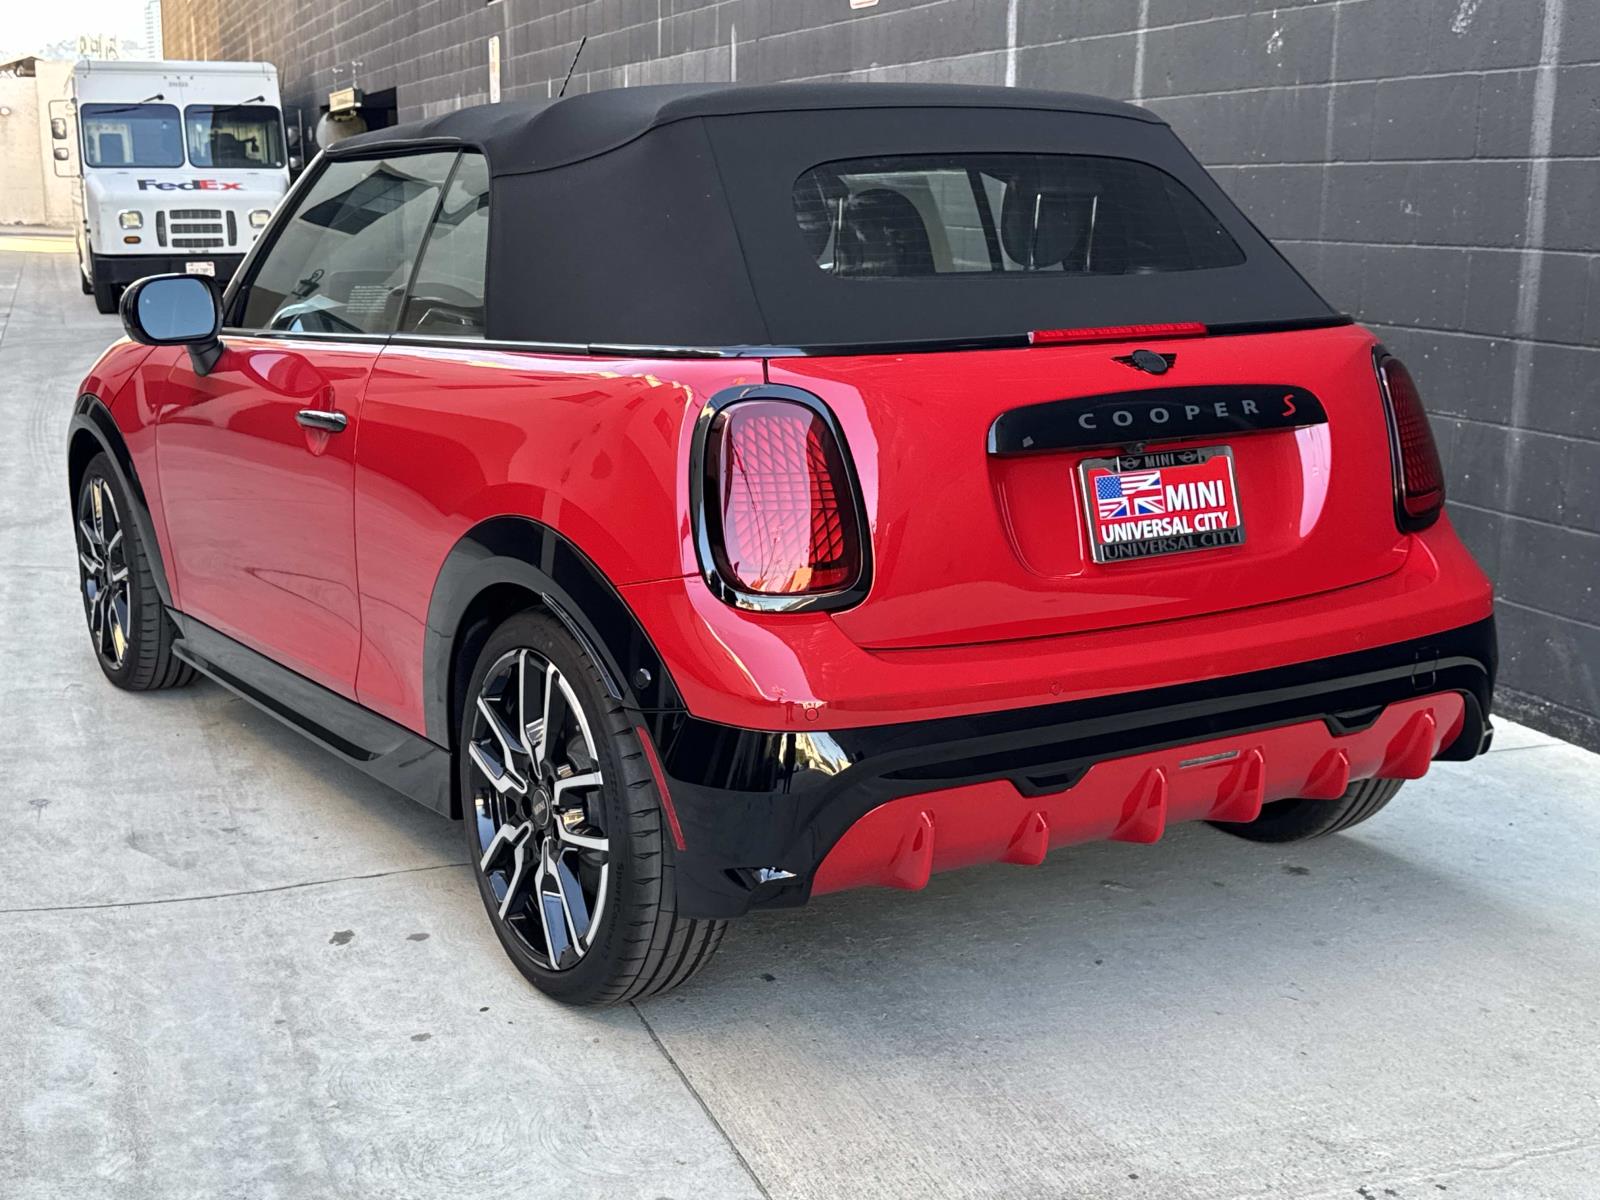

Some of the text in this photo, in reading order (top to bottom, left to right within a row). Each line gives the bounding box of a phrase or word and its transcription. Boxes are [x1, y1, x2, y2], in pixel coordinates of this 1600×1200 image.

[137, 179, 246, 191] FedEx
[1078, 394, 1296, 429] COOPER S
[1144, 453, 1175, 468] MINI
[1165, 480, 1226, 512] MINI
[1101, 511, 1228, 543] UNIVERSAL CITY
[1105, 530, 1236, 559] UNIVERSAL CITY
